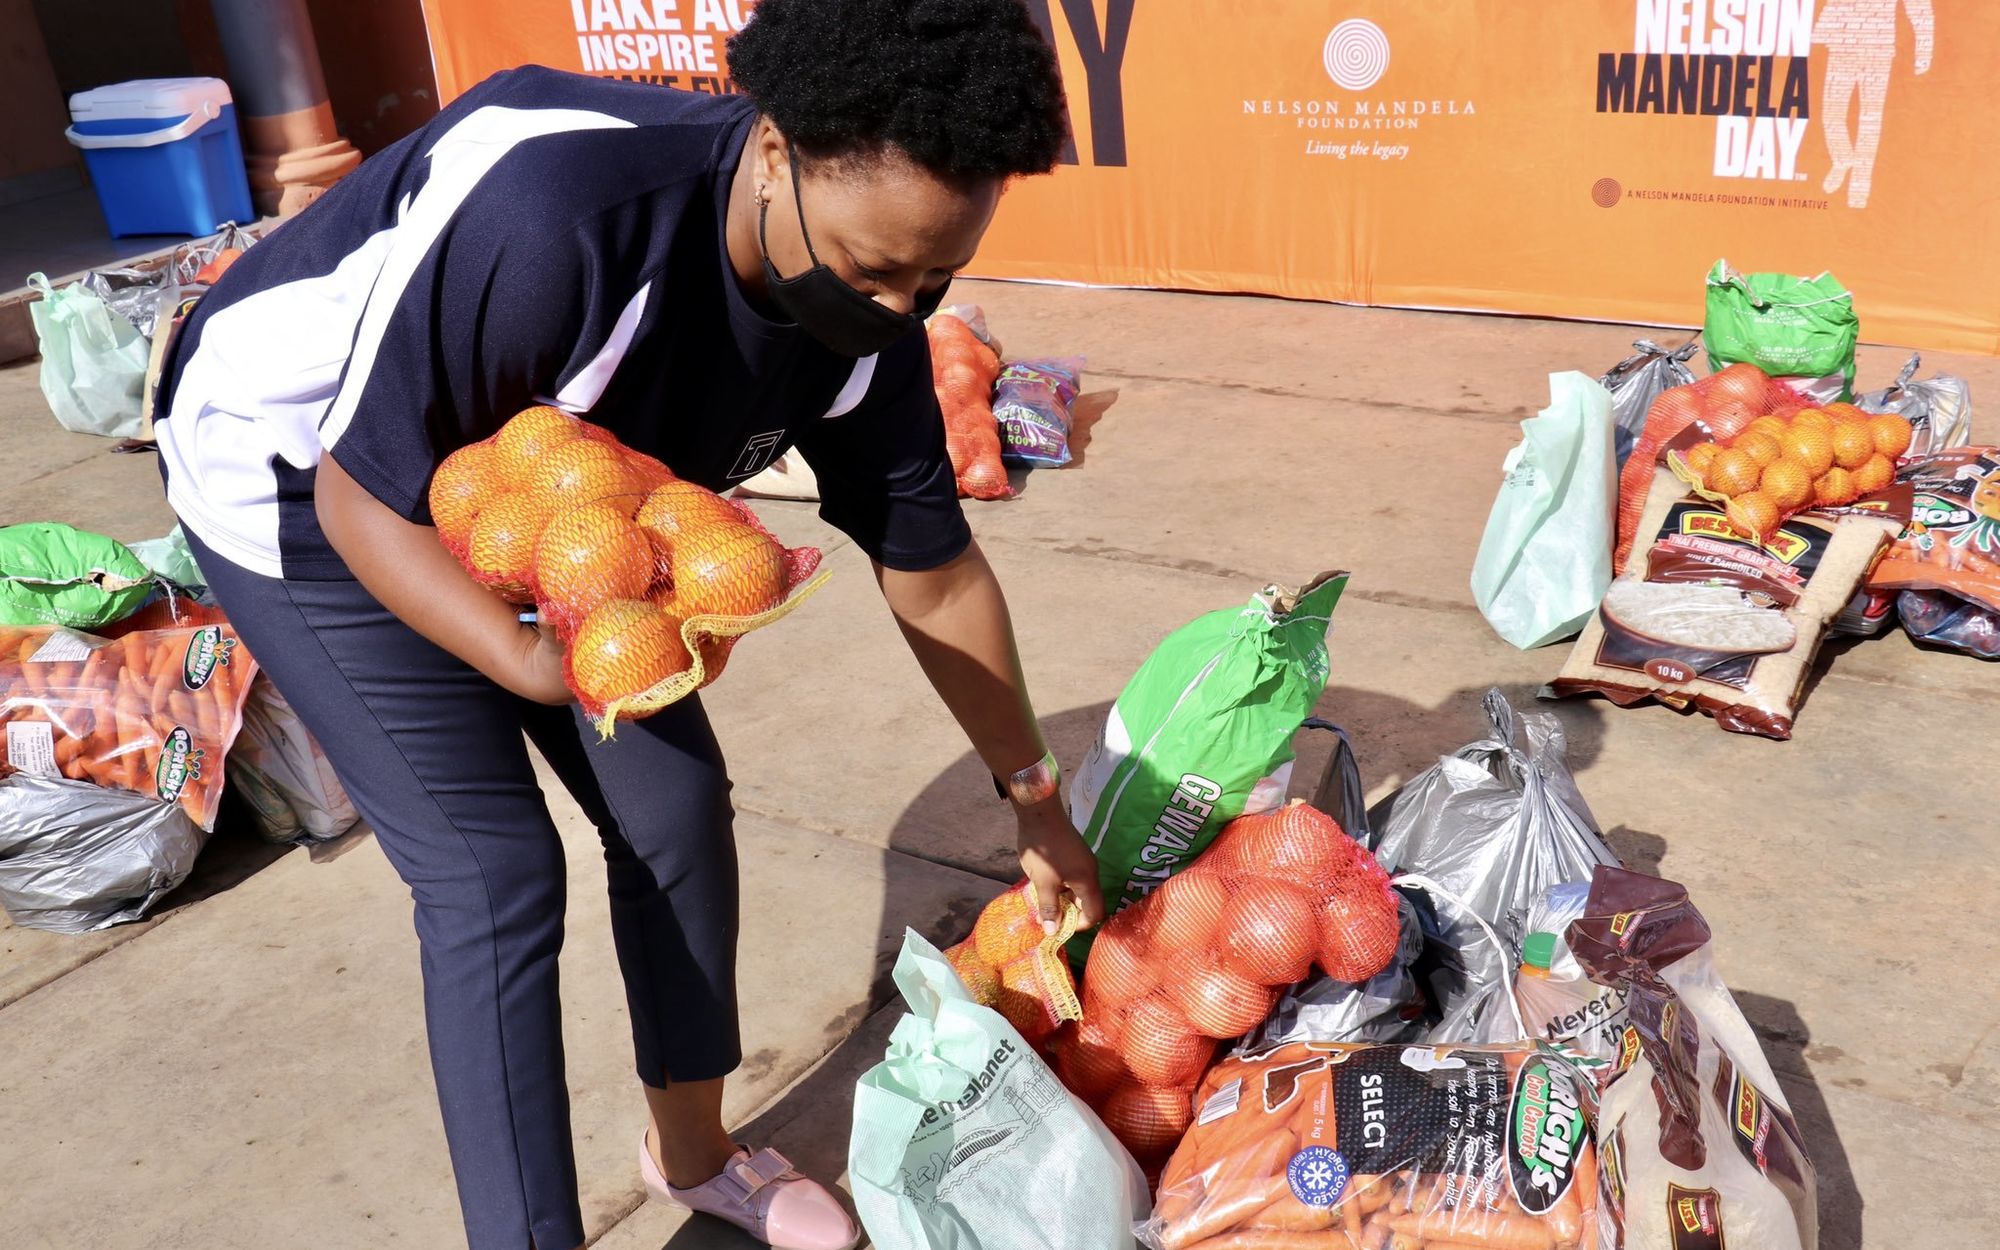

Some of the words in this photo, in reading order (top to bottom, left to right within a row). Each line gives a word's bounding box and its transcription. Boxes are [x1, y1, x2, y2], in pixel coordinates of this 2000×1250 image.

[571, 0, 681, 32] TAKE
[1634, 0, 1814, 57] NELSON
[577, 34, 718, 72] INSPIRE
[1596, 53, 1809, 118] MANDELA
[1243, 101, 1338, 113] NELSON
[1355, 101, 1475, 114] MANDELA
[1297, 117, 1419, 129] FOUNDATION
[1305, 140, 1347, 160] Living
[1350, 141, 1369, 156] the
[1372, 143, 1409, 160] legacy
[1713, 115, 1808, 180] DAY
[1627, 189, 1634, 199] A
[1636, 190, 1668, 201] NELSON
[1671, 191, 1714, 203] MANDELA
[1717, 194, 1776, 208] FOUNDATION
[1778, 198, 1829, 211] INITIATIVE
[1691, 541, 1735, 556] PREMIUM
[1736, 551, 1770, 567] GRADE
[1656, 664, 1670, 676] 10
[1671, 667, 1684, 681] kg
[163, 729, 188, 801] RORICH'S
[1546, 992, 1611, 1040] Never
[1464, 1067, 1480, 1098] keeping
[1525, 1074, 1546, 1102] Cool
[1361, 1074, 1387, 1149] SELECT
[1447, 1095, 1462, 1112] soil
[1486, 1108, 1496, 1126] are
[1311, 1127, 1324, 1139] kg
[1518, 1105, 1544, 1159] Carrots
[1531, 1058, 1578, 1195] RORICH'S
[1315, 1147, 1346, 1173] HYDRO
[1446, 1133, 1457, 1165] your
[1464, 1134, 1479, 1169] fresh
[1313, 1175, 1347, 1204] COOLED
[1446, 1172, 1459, 1206] table
[1466, 1174, 1479, 1209] from
